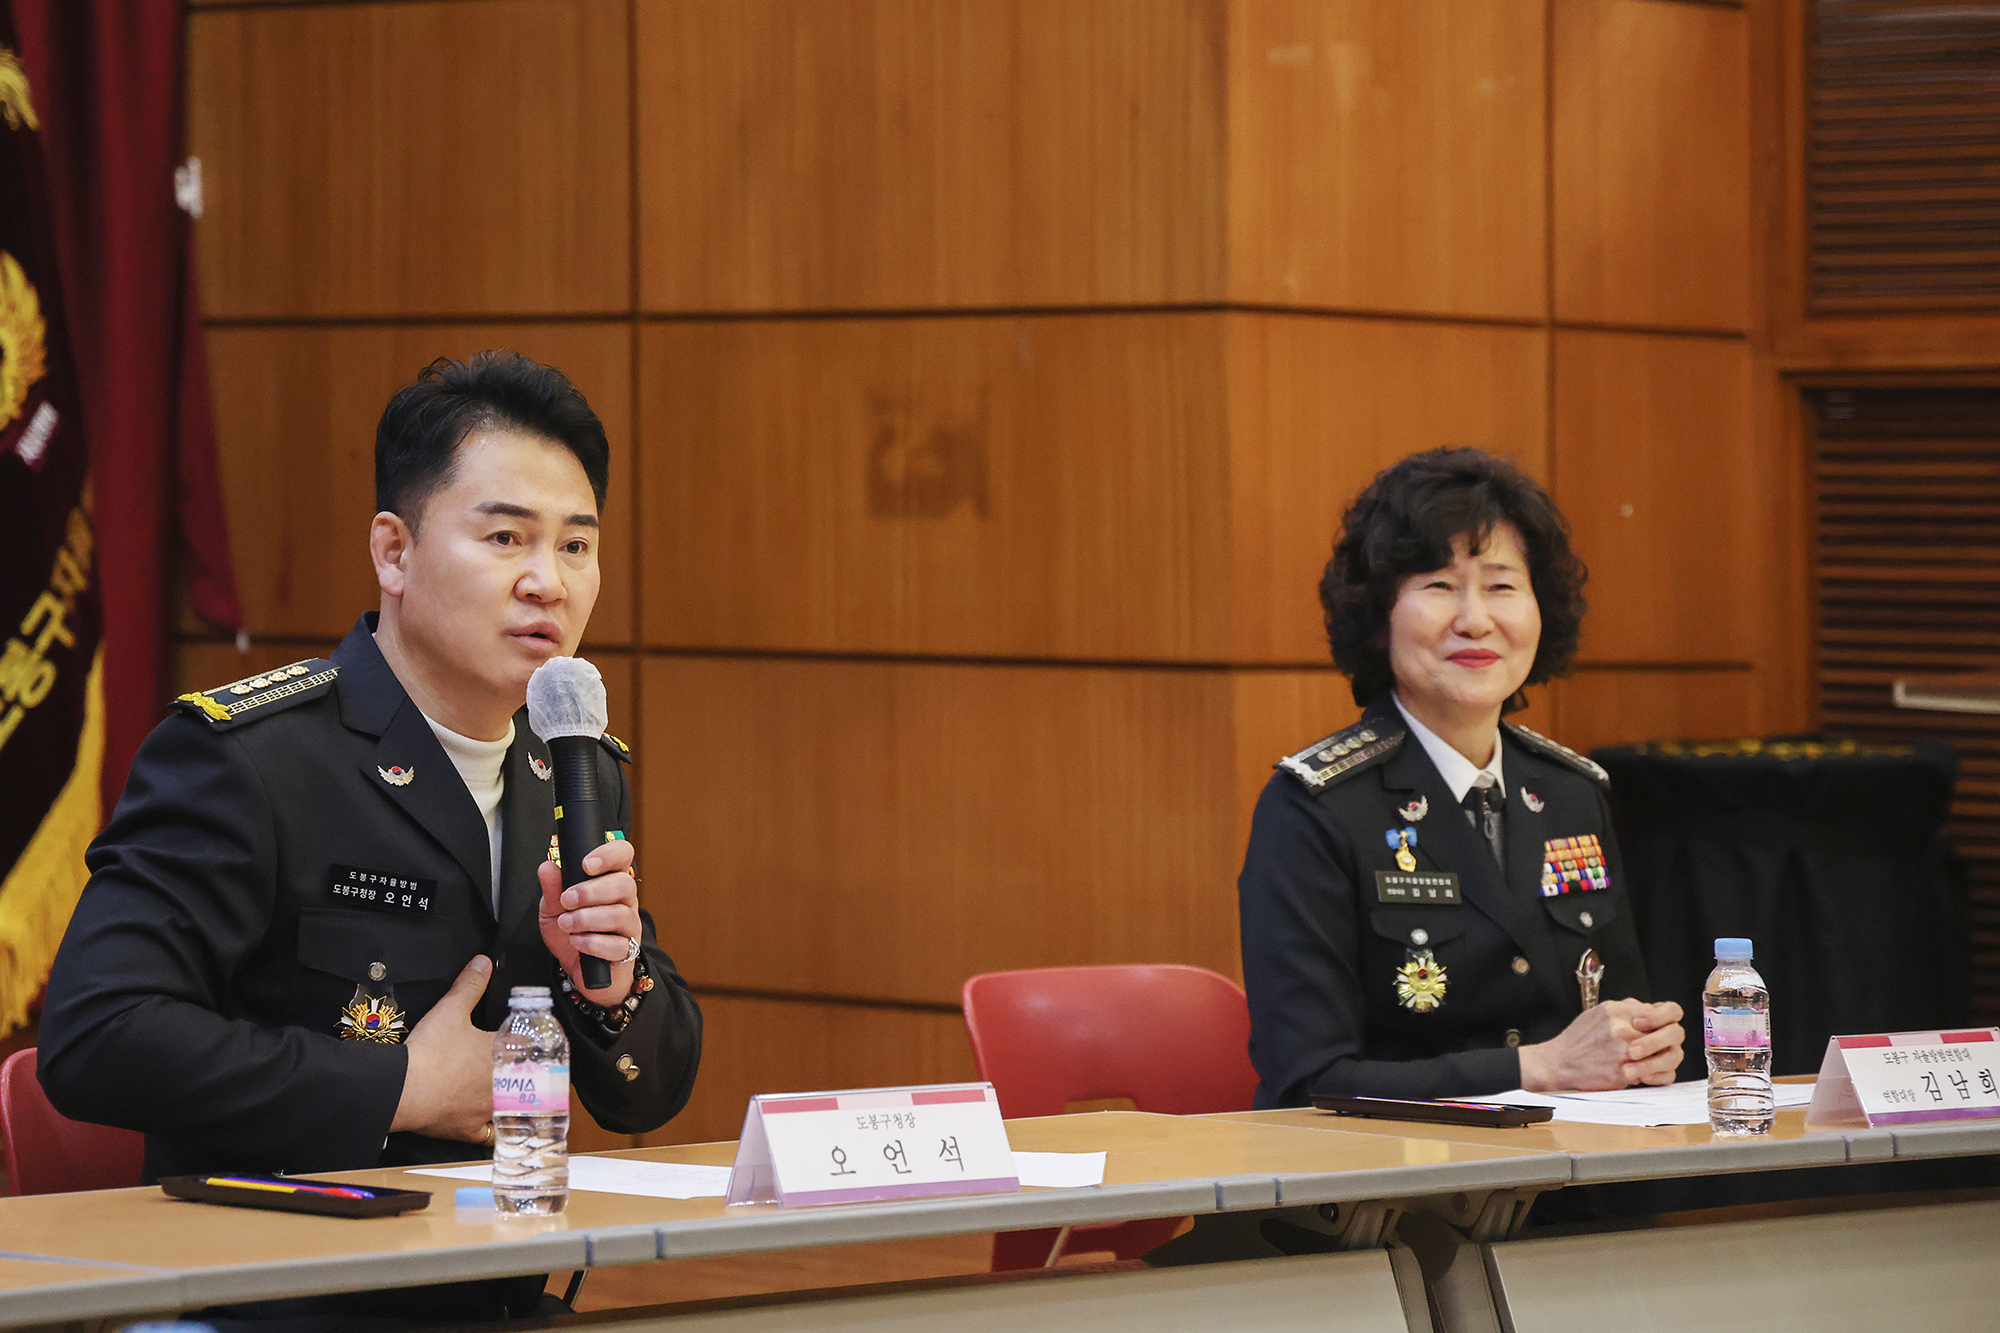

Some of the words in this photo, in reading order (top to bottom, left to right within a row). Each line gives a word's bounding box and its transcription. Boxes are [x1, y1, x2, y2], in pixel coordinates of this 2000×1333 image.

[349, 871, 418, 891] 도봉구자율방범
[333, 884, 377, 900] 도봉구청장
[1882, 1051, 1909, 1064] 도봉구
[1913, 1048, 1973, 1064] 자율방범연합대
[1882, 1089, 1917, 1103] 연합대장
[856, 1112, 916, 1131] 도봉구청장
